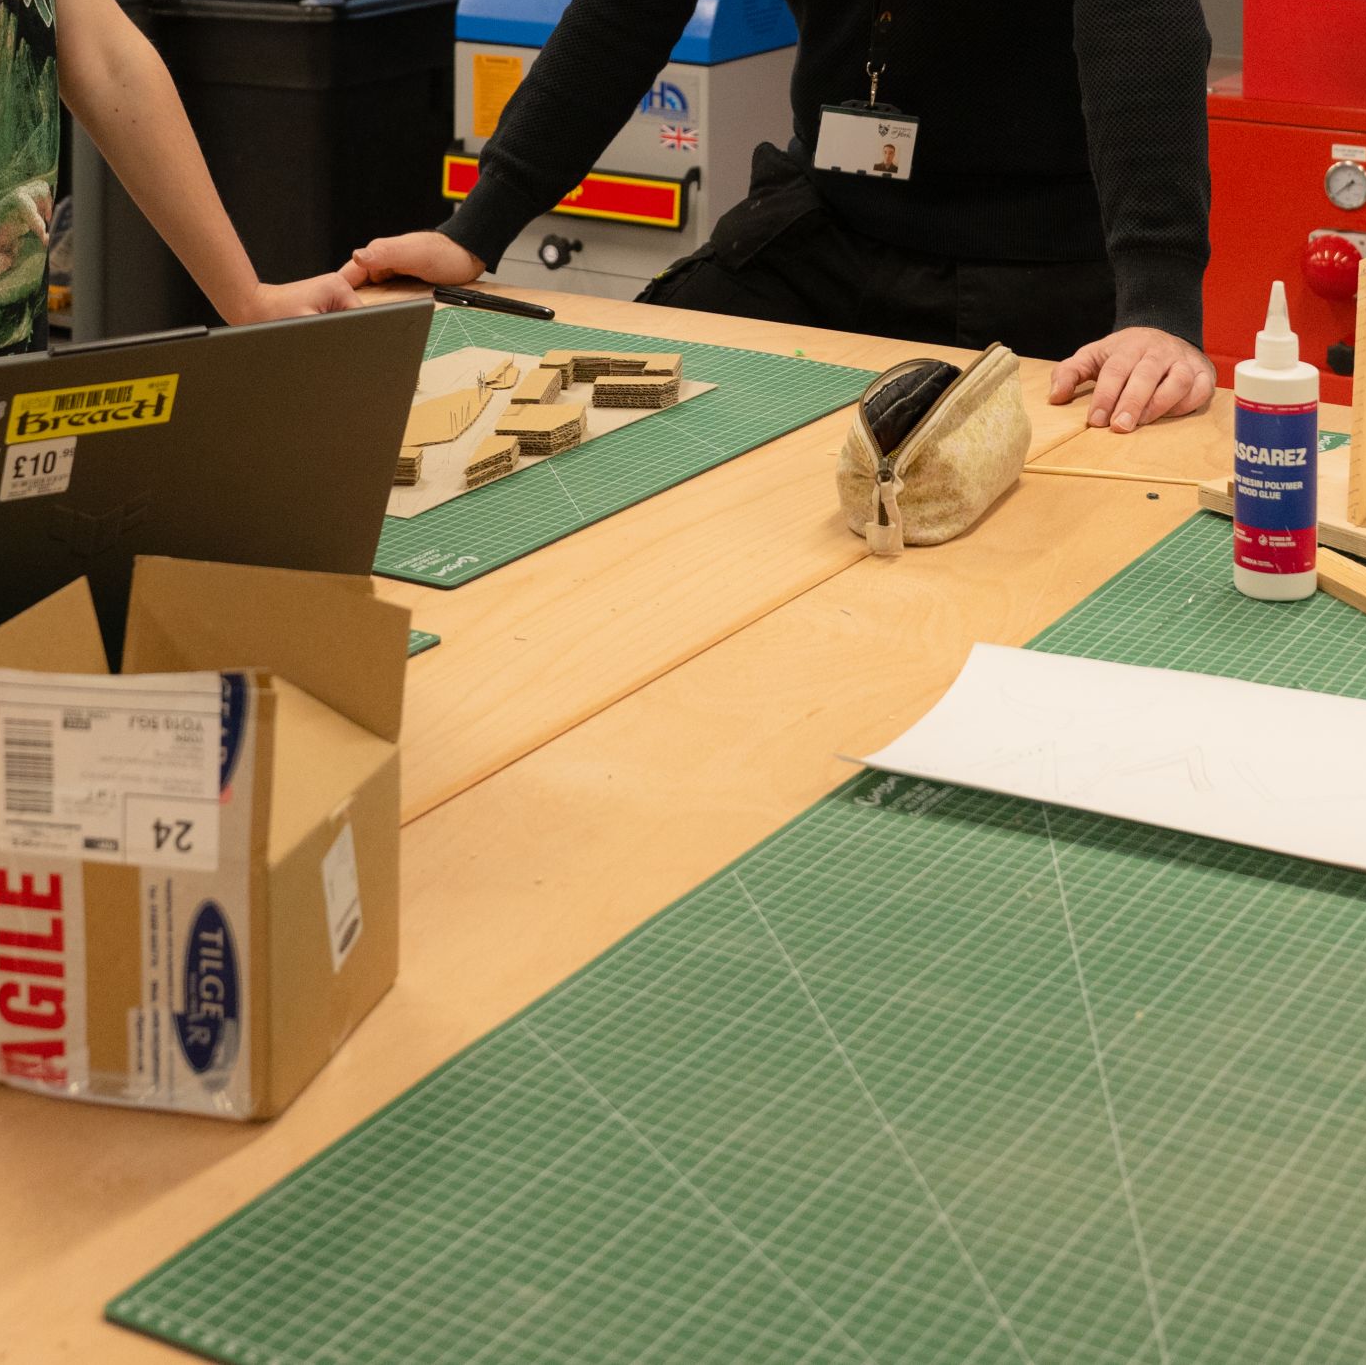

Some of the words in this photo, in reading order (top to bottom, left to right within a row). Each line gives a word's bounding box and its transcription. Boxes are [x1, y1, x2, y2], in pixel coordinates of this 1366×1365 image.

[1242, 476, 1263, 488] RESIN
[1264, 481, 1303, 490] POLYMER
[1238, 484, 1258, 497] WOOD
[1258, 490, 1282, 500] GLUE
[151, 818, 195, 854] 24
